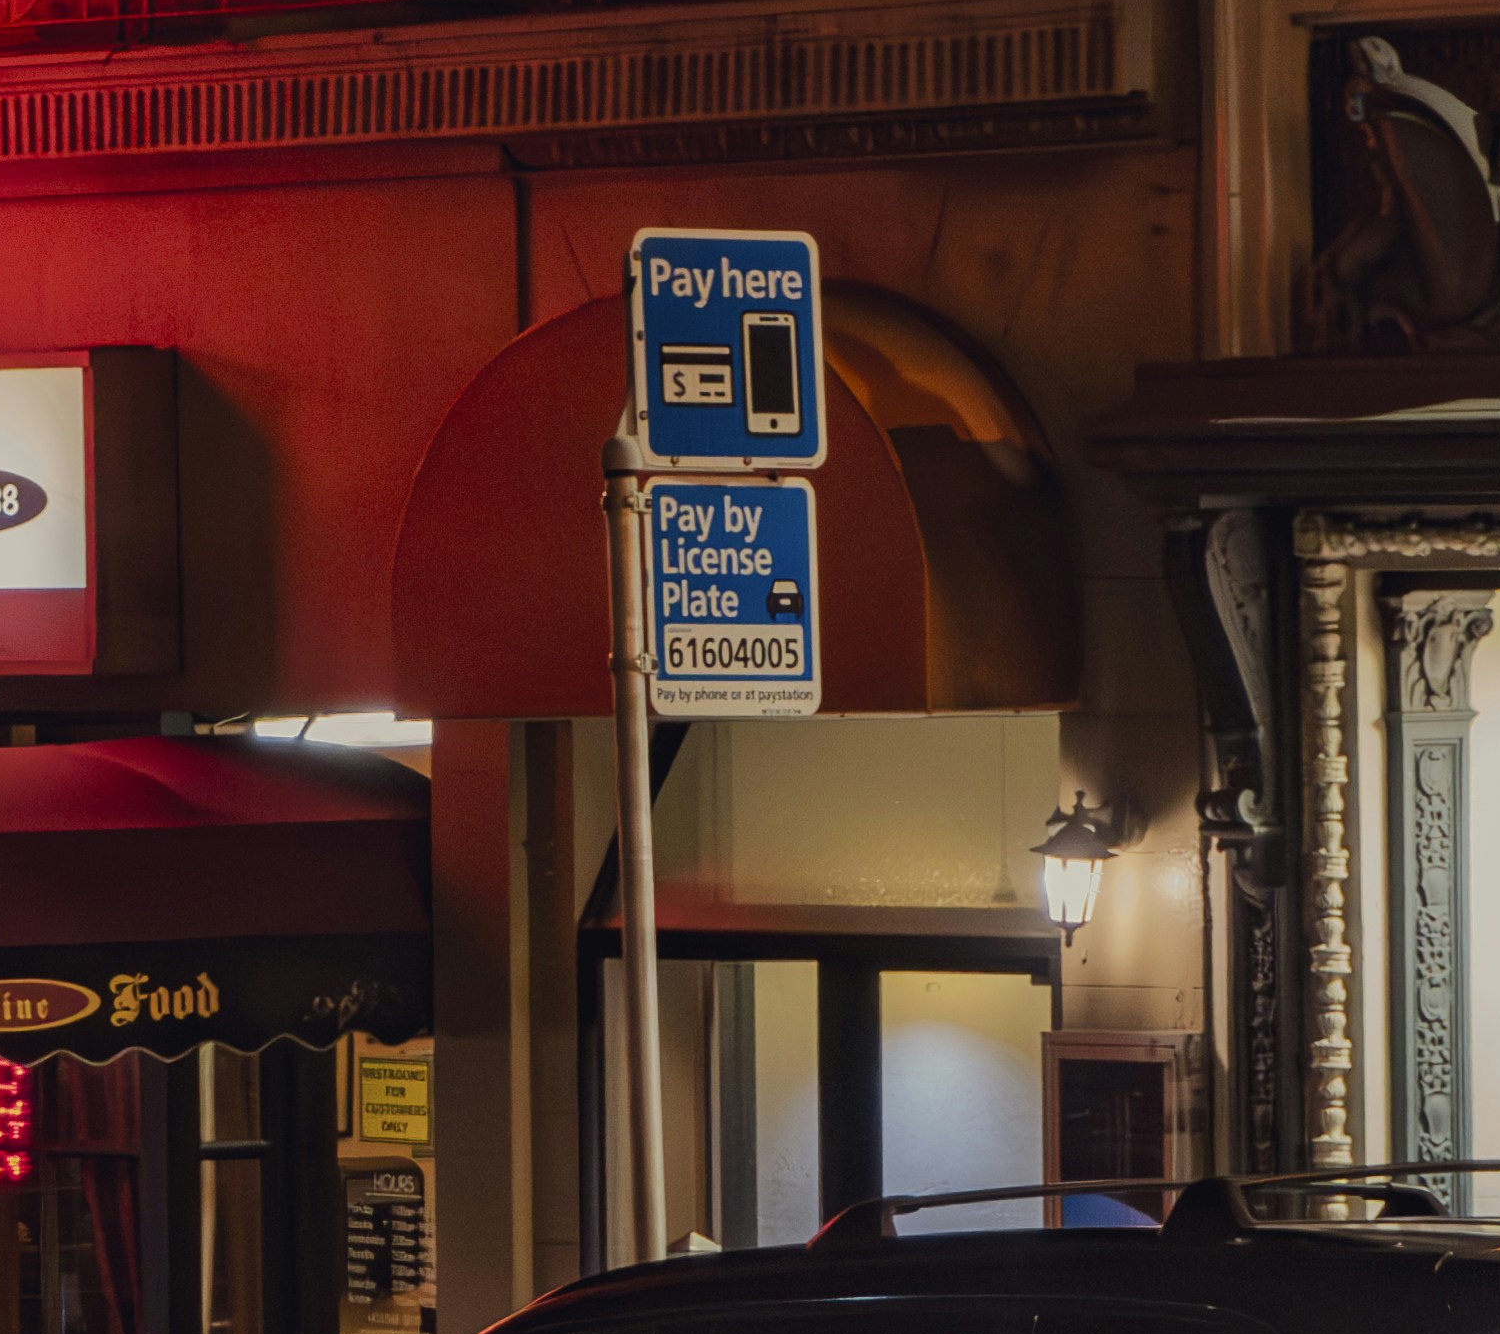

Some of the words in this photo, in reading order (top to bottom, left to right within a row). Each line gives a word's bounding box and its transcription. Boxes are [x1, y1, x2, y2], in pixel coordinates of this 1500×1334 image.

[649, 257, 716, 308] Pay
[721, 257, 804, 301] here
[659, 494, 715, 542] Pay
[723, 494, 763, 544] by
[661, 537, 773, 576] License
[661, 580, 740, 619] Plate
[668, 636, 800, 671] 61604005
[657, 687, 676, 704] Pay
[678, 686, 692, 703] by
[694, 686, 728, 702] phone
[758, 687, 814, 704] paystation
[108, 971, 221, 1029] Food
[384, 1085, 407, 1098] FOR
[373, 1172, 416, 1194] HOURS
